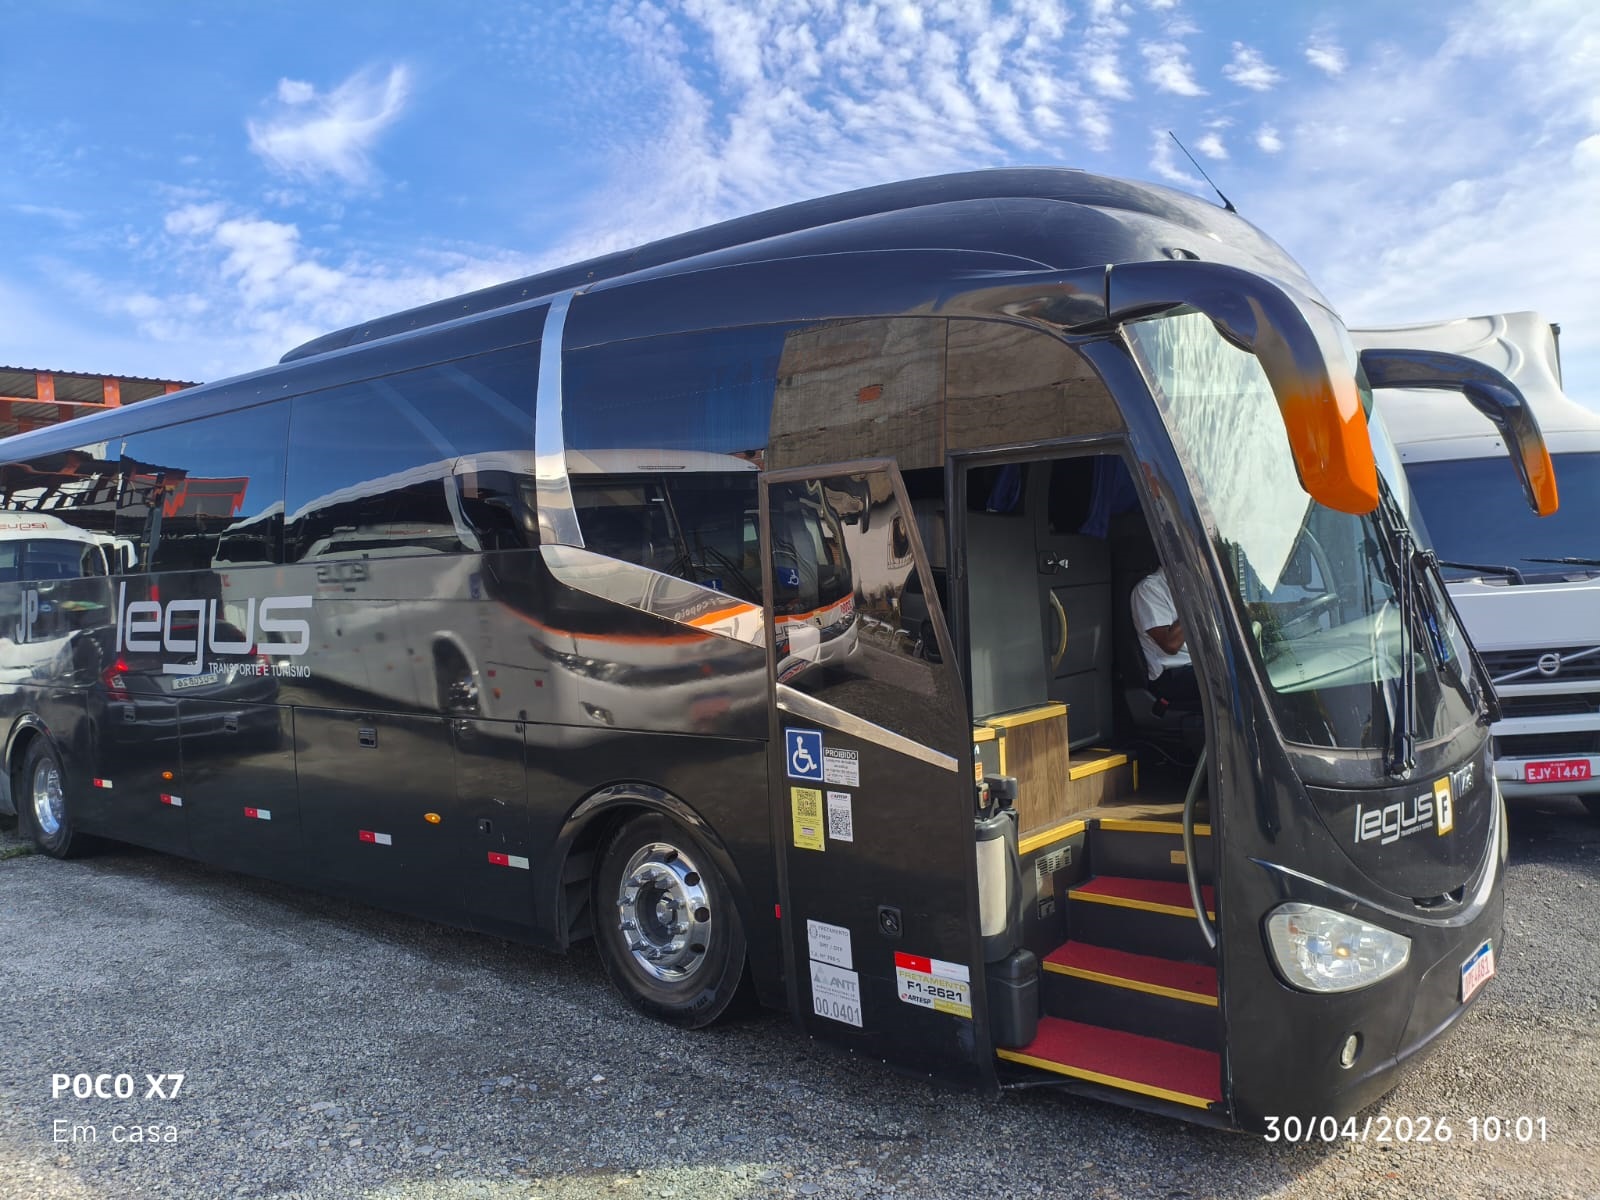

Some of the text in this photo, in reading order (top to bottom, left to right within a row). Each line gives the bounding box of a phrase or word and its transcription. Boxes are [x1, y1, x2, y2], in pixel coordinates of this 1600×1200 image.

[116, 581, 313, 675] legus
[208, 662, 311, 678] TRANSPORTE E TURISMO
[825, 748, 857, 760] PROIBIDO
[1354, 792, 1433, 845] legus
[830, 976, 856, 992] ANTT
[899, 969, 967, 992] FRETAMENTO
[907, 980, 963, 1002] F1-2621
[908, 993, 932, 1004] ARTESP
[815, 996, 861, 1025] 00.0401
